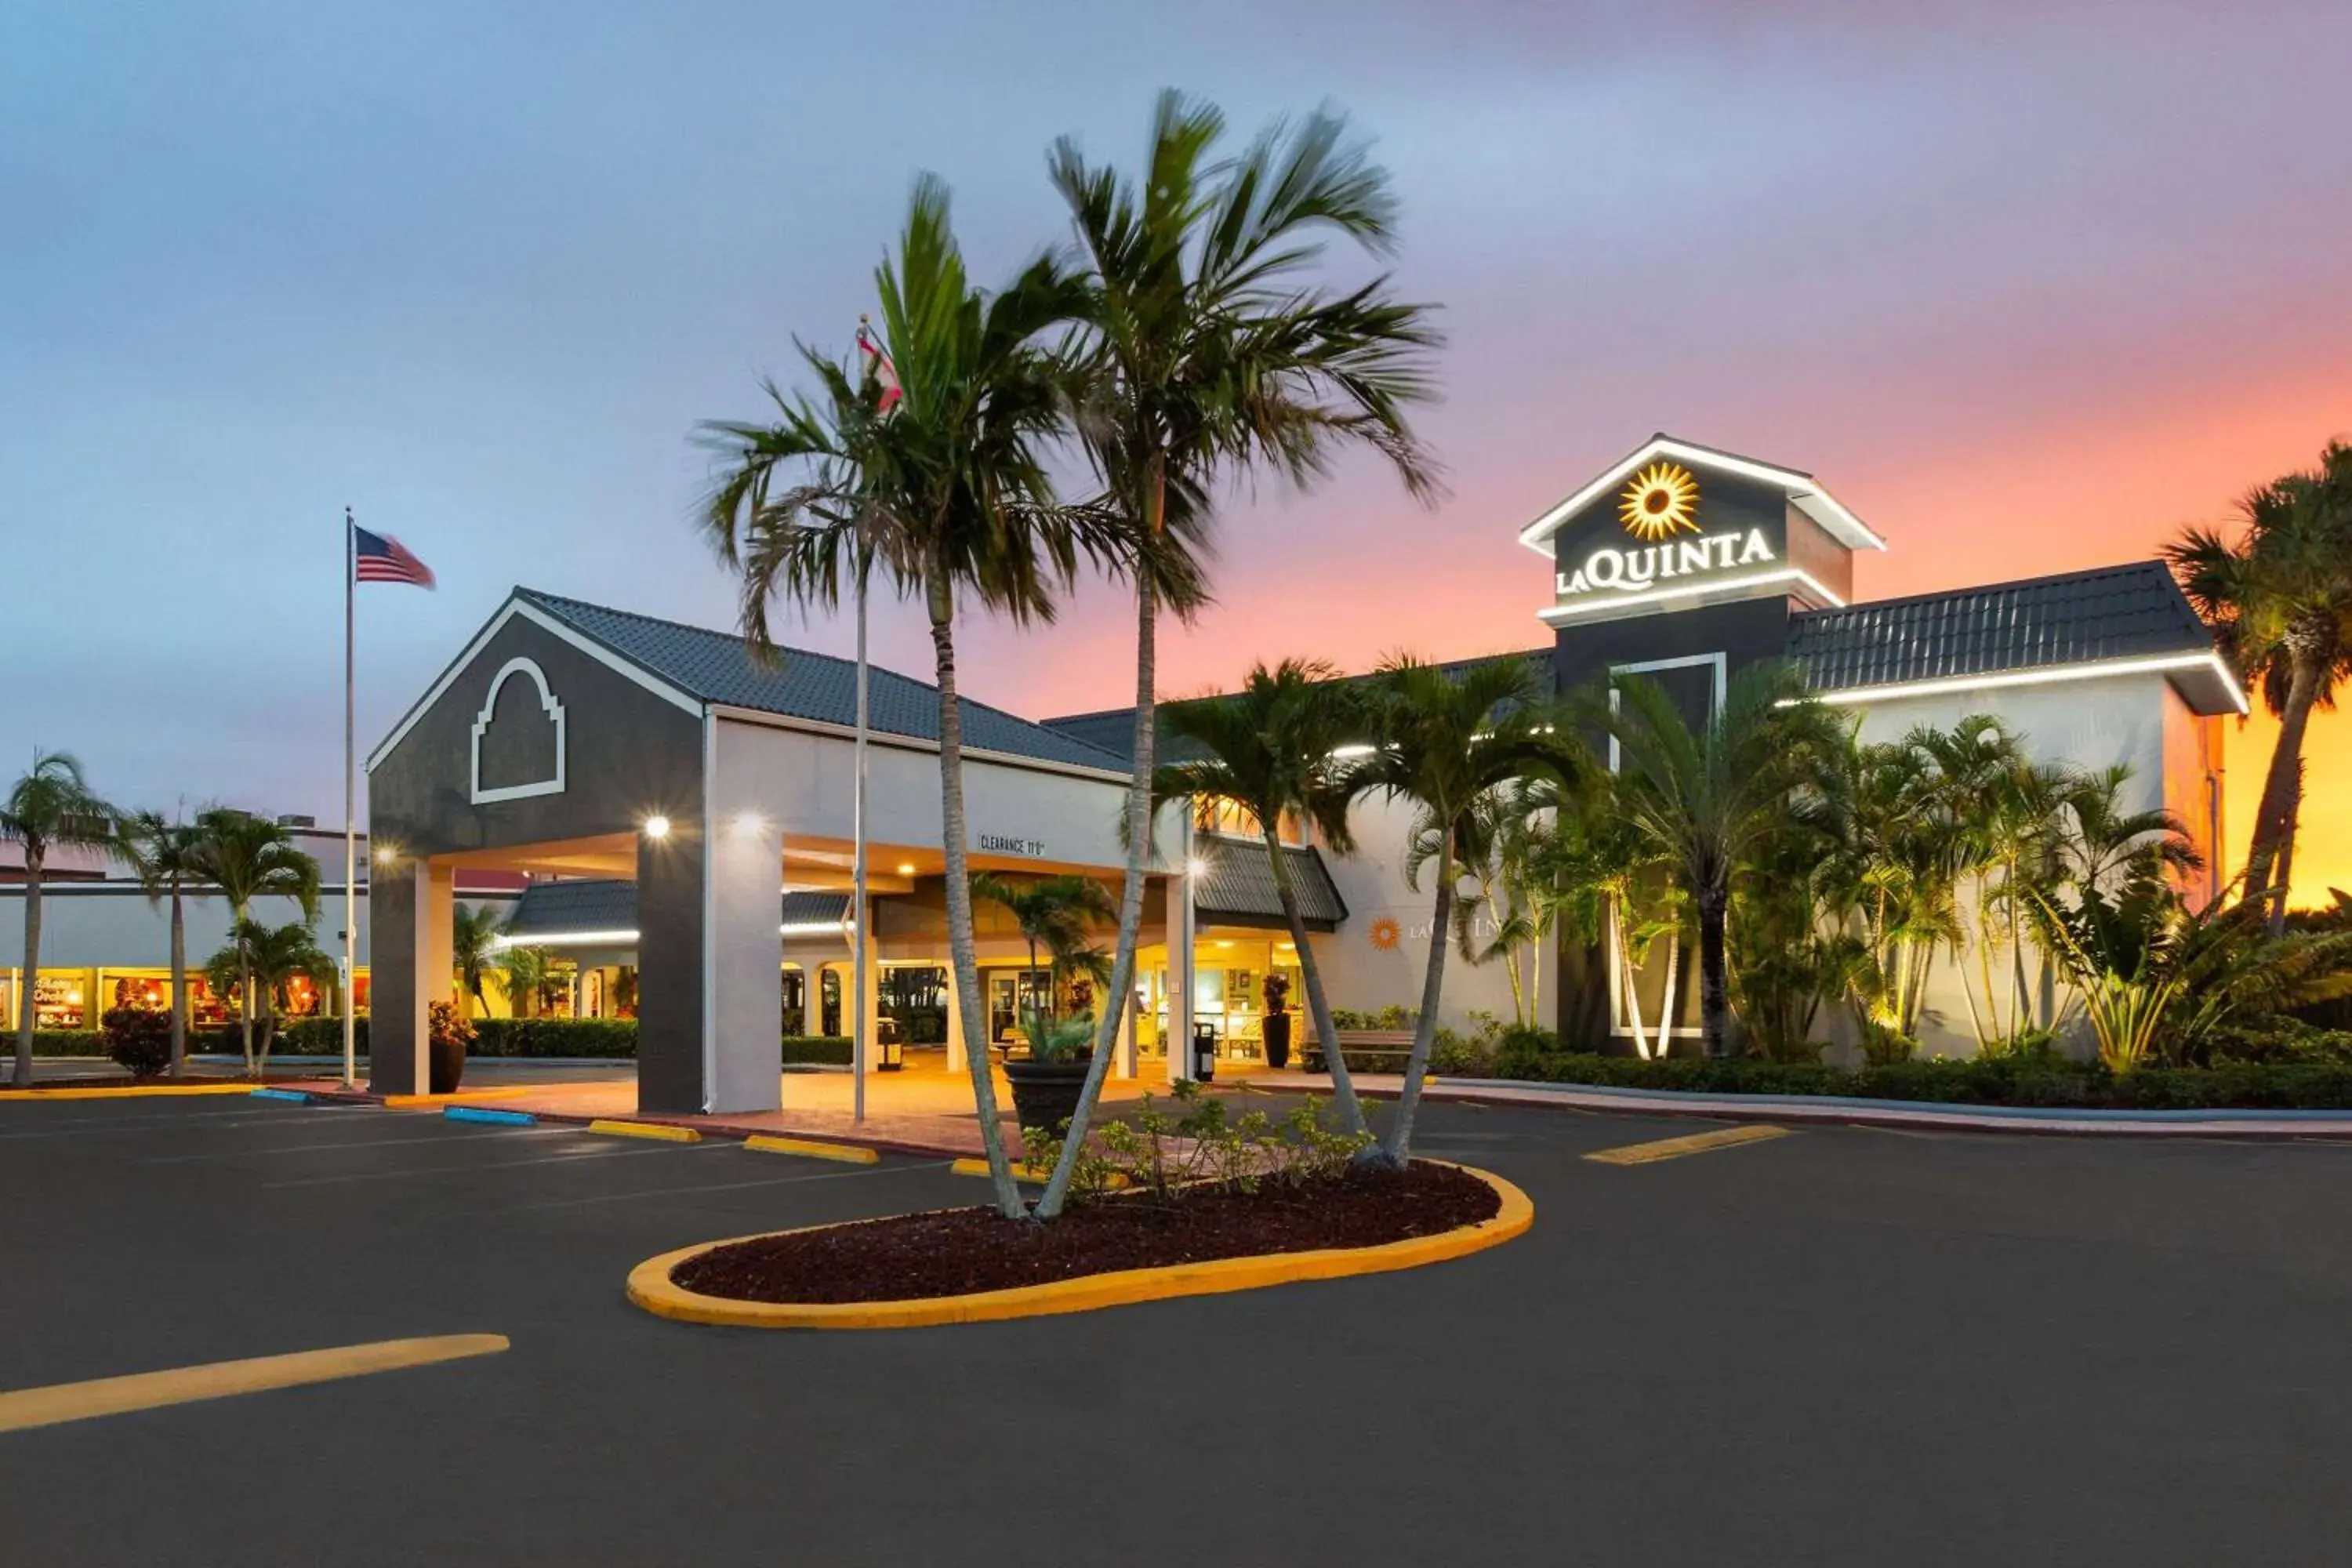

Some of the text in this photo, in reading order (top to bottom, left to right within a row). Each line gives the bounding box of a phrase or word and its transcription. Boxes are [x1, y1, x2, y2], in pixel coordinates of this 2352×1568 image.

[1555, 528, 1776, 593] LA QUINTA
[981, 835, 1024, 853] CLEARANCE
